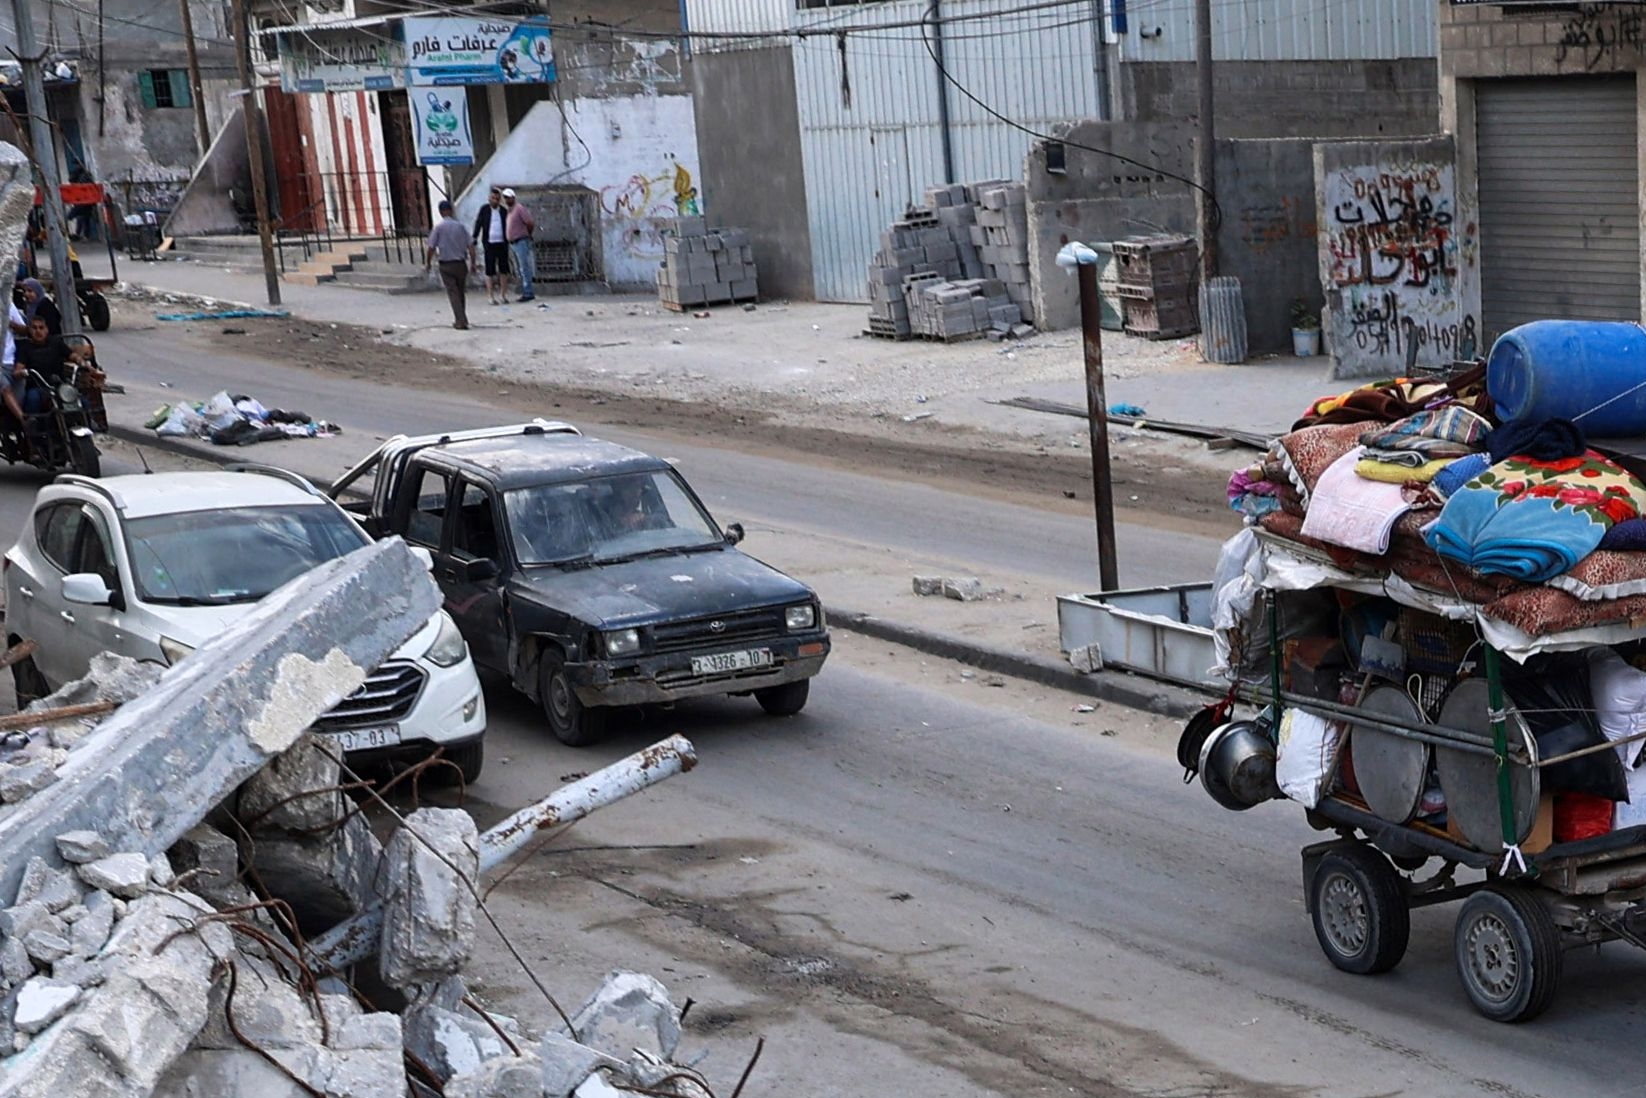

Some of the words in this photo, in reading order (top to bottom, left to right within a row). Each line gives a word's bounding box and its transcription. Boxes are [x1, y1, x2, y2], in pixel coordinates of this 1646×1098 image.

[477, 23, 511, 36] صيدلية
[412, 34, 441, 60] فارم
[447, 34, 498, 53] عرفات
